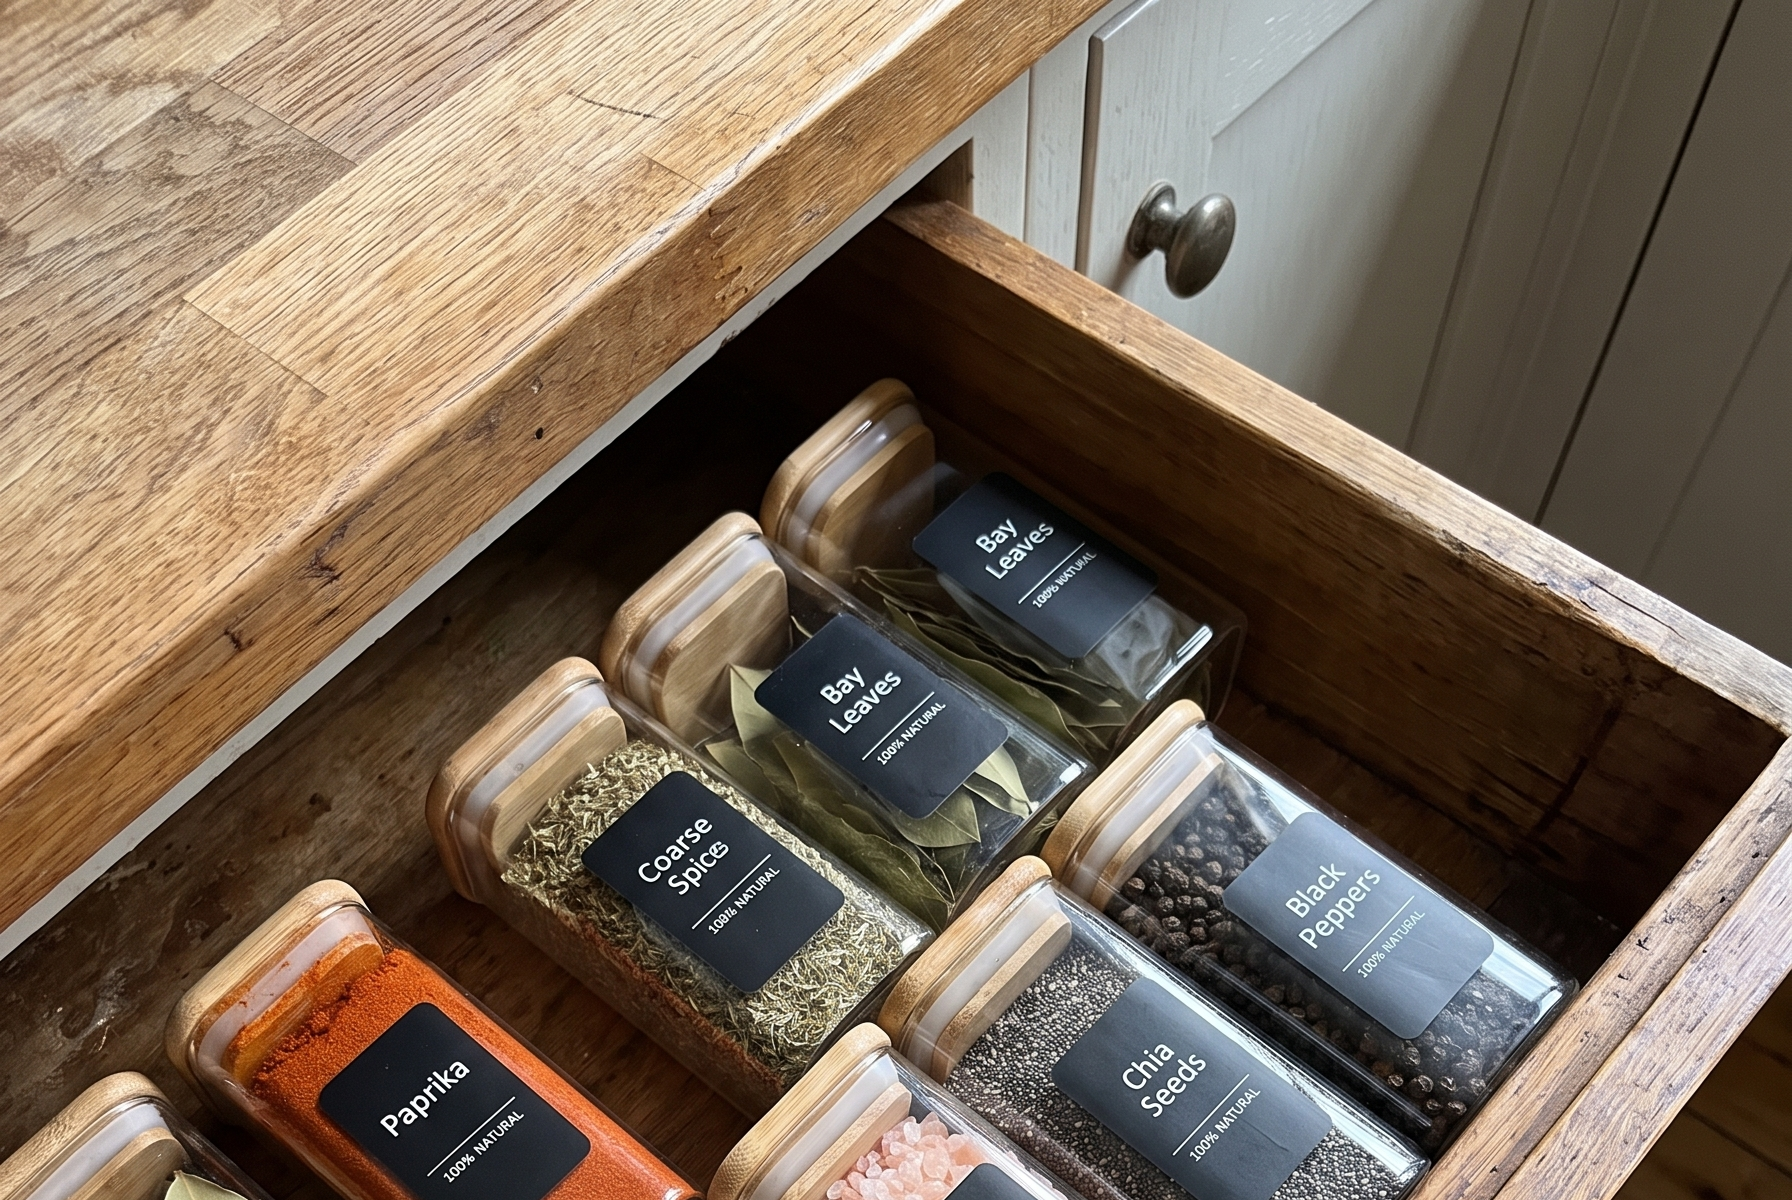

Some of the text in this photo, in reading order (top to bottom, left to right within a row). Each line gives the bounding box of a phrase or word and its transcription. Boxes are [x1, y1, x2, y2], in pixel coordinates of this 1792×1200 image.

[976, 518, 1017, 553] Bay
[985, 522, 1054, 579] Leaves
[820, 666, 865, 705] Bay
[829, 671, 901, 734] Leaves
[877, 702, 946, 765] 100% NATURAL
[638, 818, 713, 883] Coarse
[734, 867, 780, 909] NATURAL
[1285, 863, 1347, 918] Black
[1298, 869, 1380, 949] Peppers
[1357, 951, 1385, 978] 100%
[1122, 1044, 1175, 1090] Chia
[1141, 1054, 1206, 1118] Seeds
[380, 1061, 470, 1137] Paprika
[1189, 1088, 1261, 1162] 100% NATURAL
[443, 1111, 525, 1183] 100% NATURAL
